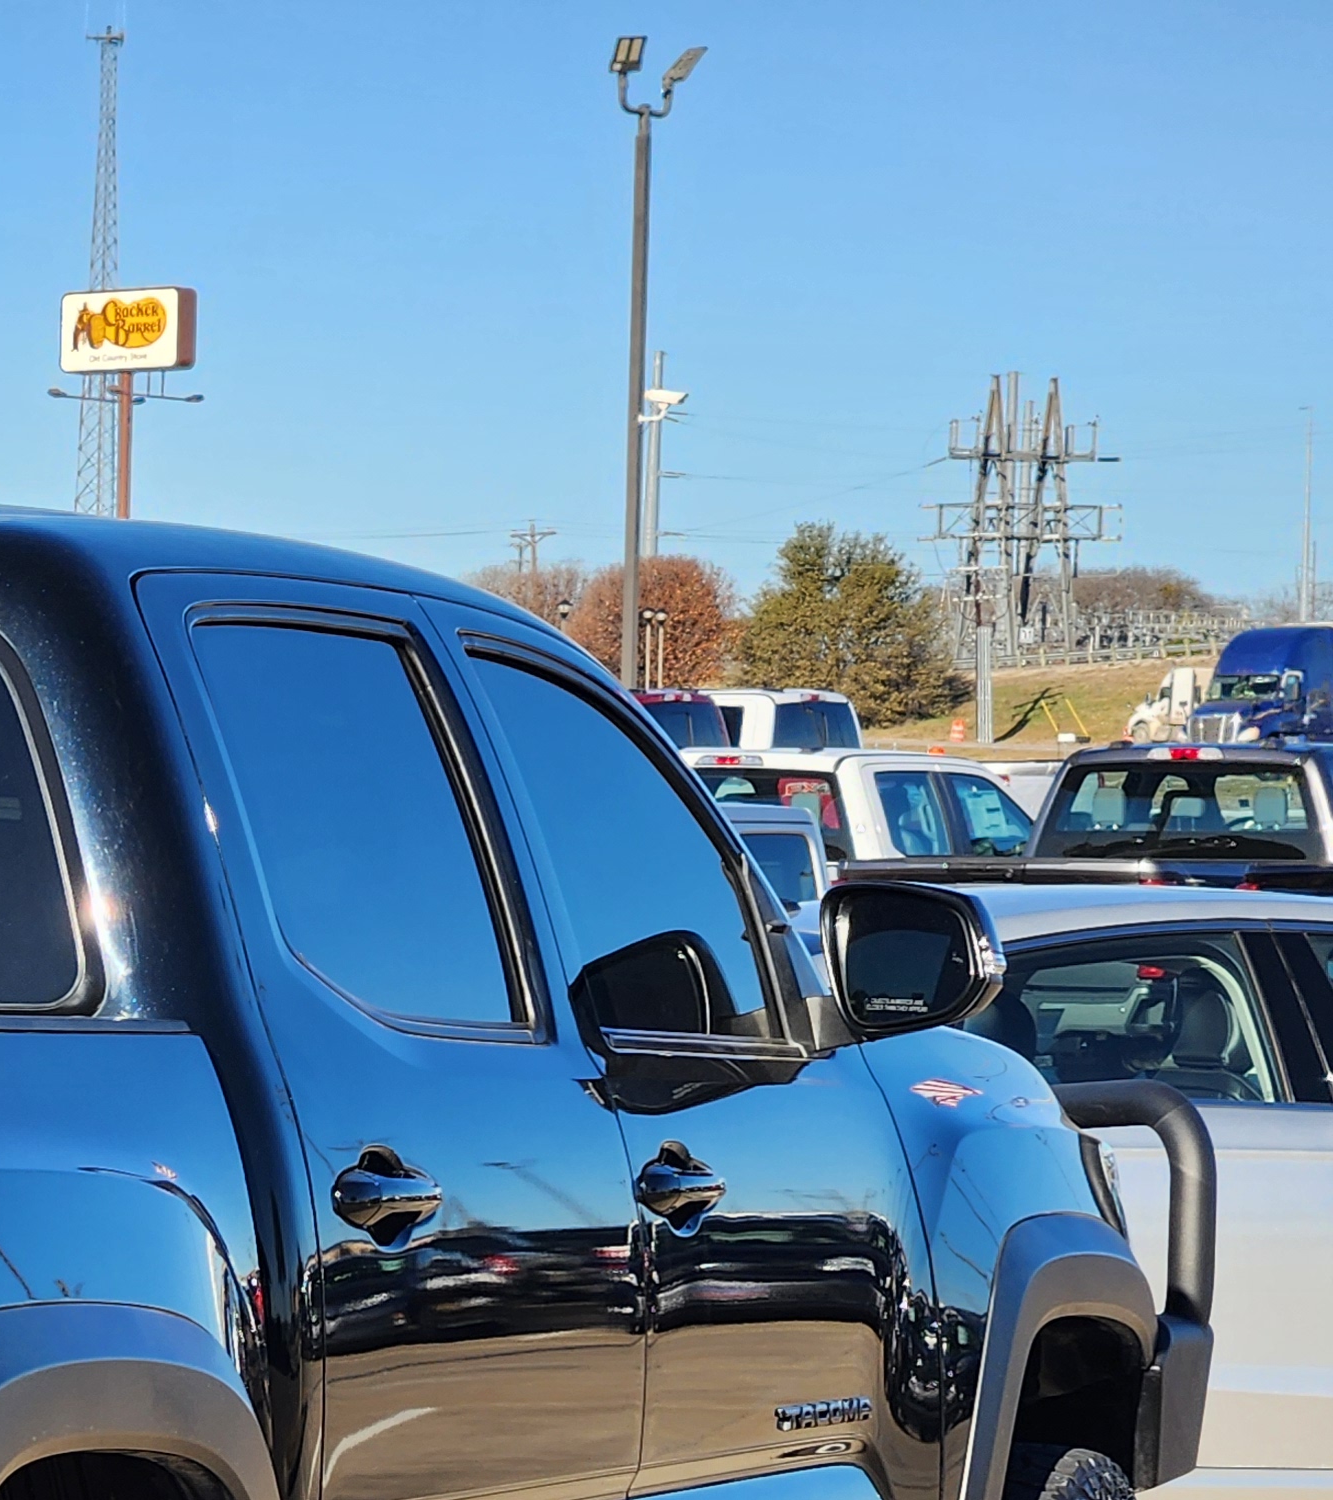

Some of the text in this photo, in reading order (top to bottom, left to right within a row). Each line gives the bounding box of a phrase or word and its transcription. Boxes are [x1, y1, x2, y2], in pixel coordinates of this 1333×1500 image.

[102, 299, 160, 326] Cracker
[115, 318, 162, 347] Barrel
[775, 1396, 873, 1431] TACOMA
